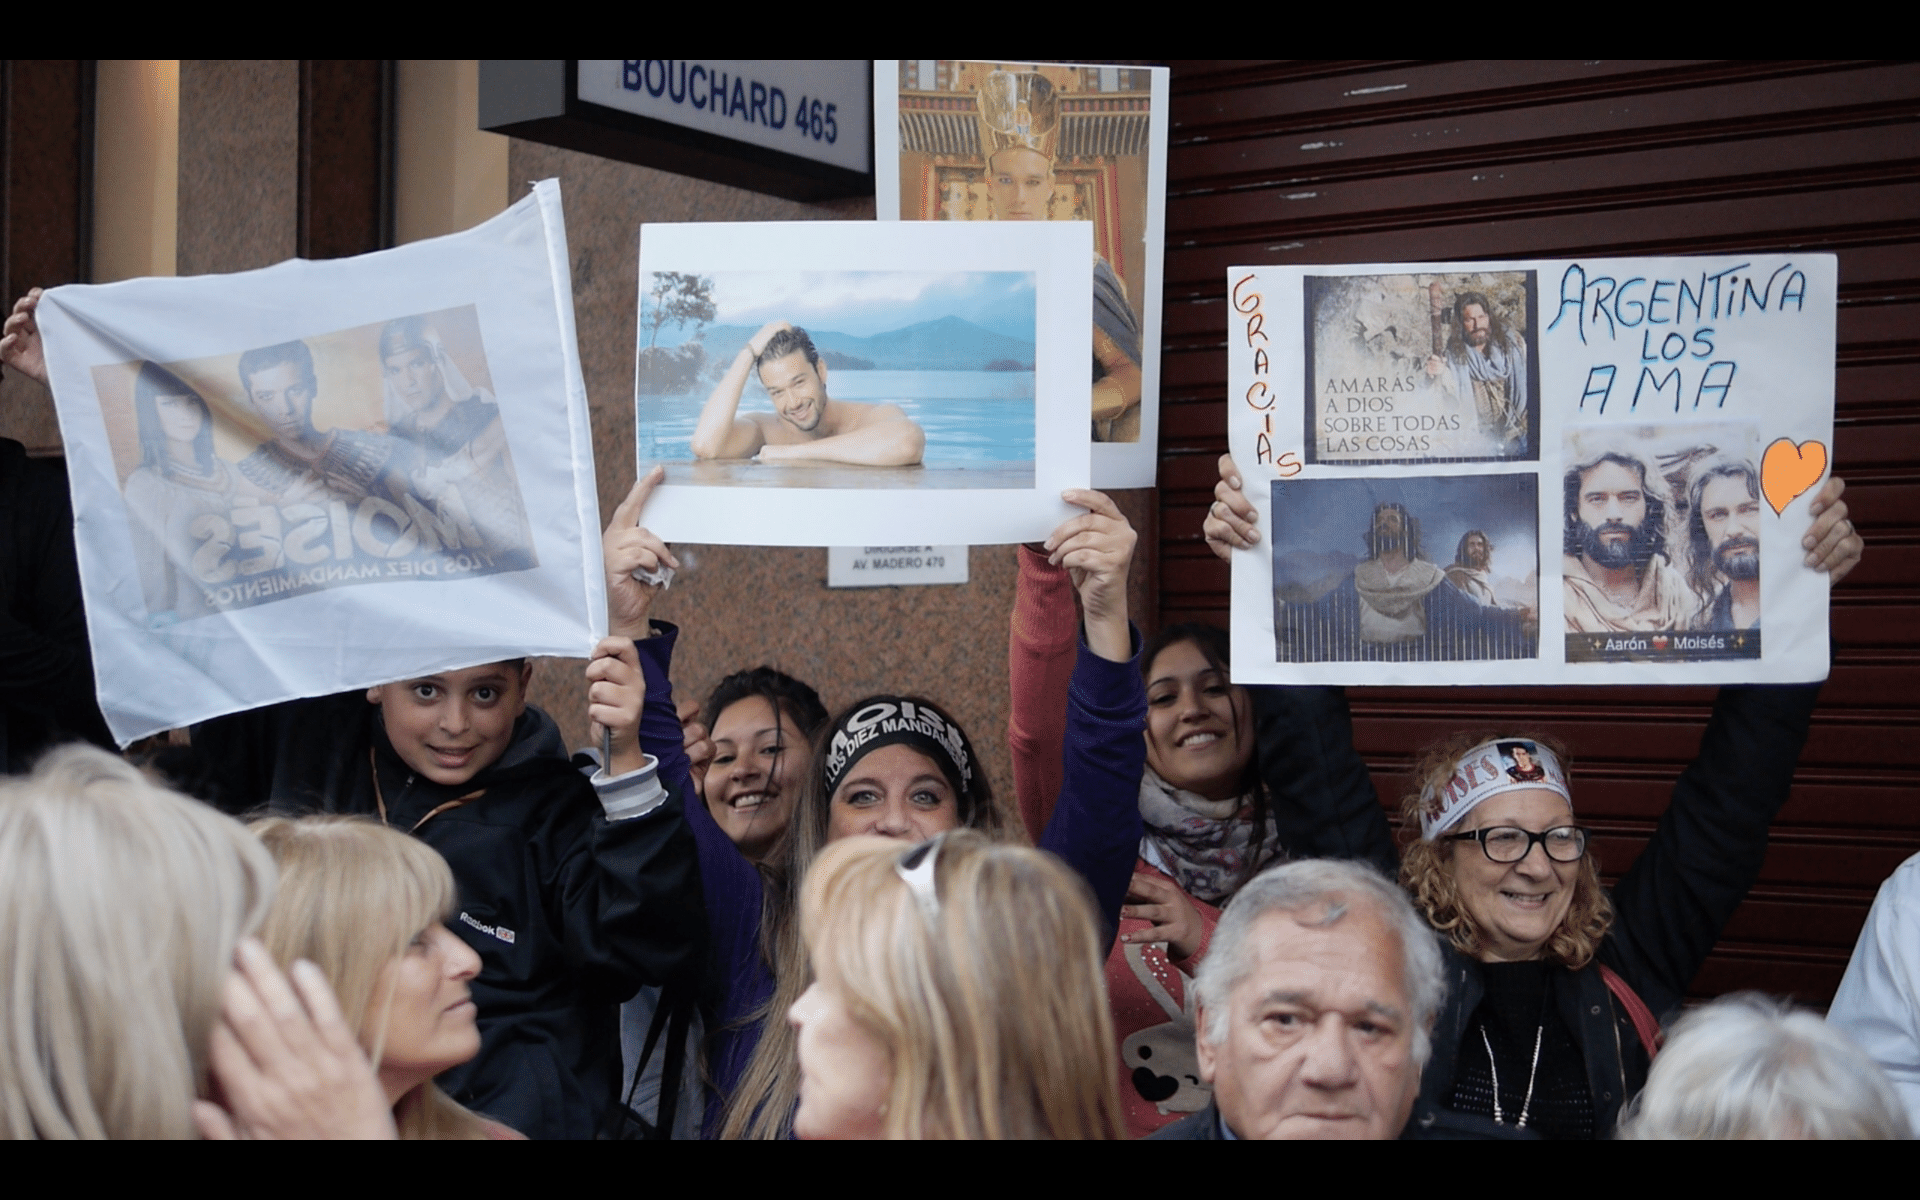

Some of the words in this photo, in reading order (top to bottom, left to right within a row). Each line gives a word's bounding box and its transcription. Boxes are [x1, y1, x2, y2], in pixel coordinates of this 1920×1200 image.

[622, 60, 787, 130] BOUCHARD
[795, 95, 838, 144] 465
[1641, 327, 1715, 363] LOS
[1325, 372, 1415, 394] AMARÁS
[1579, 361, 1738, 415] AMA
[1326, 398, 1339, 413] A
[1347, 397, 1394, 413] DIOS
[1324, 416, 1386, 433] SOBRE
[1392, 414, 1460, 432] TODAS
[1326, 437, 1360, 453] LAS
[1366, 435, 1430, 451] COSAS
[872, 557, 923, 570] MADERO
[925, 556, 945, 568] 470
[1605, 637, 1647, 651] Aarón
[1674, 635, 1724, 650] Moisés
[826, 751, 846, 784] LOS
[845, 723, 880, 758] DIEZ
[460, 911, 495, 936] Reebok
